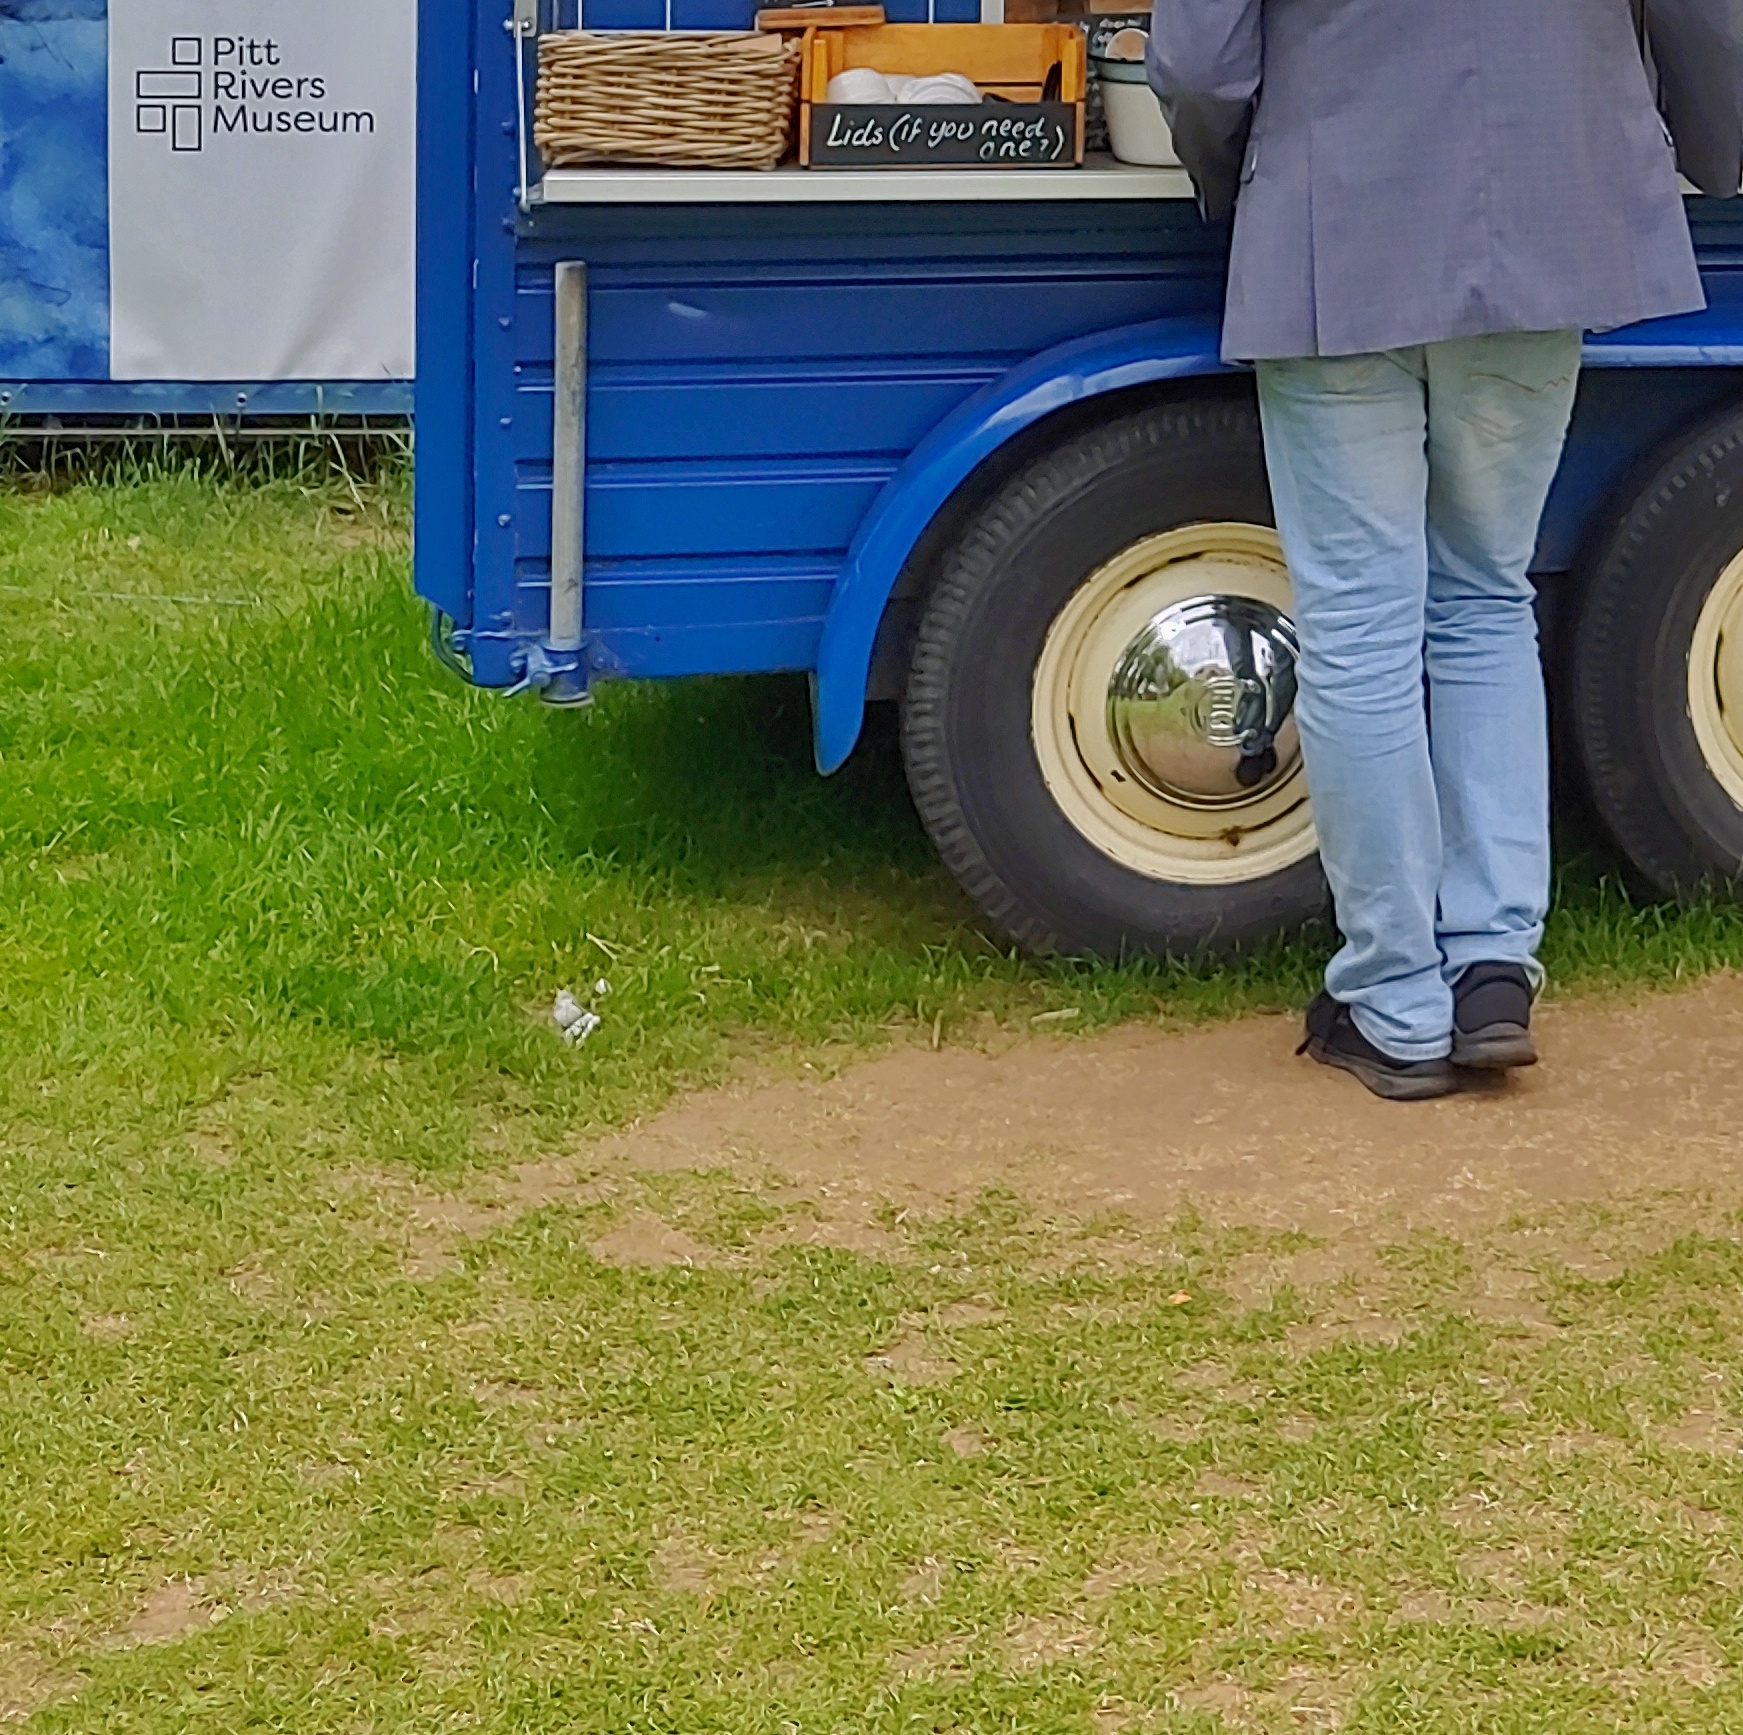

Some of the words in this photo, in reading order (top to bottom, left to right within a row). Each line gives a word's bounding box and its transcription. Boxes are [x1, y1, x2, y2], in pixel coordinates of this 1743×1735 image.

[213, 37, 280, 66] Pitt
[213, 71, 325, 100] Rivers
[213, 105, 375, 133] Museum
[827, 114, 884, 146] Lids
[928, 119, 974, 148] you
[981, 117, 1045, 138] need
